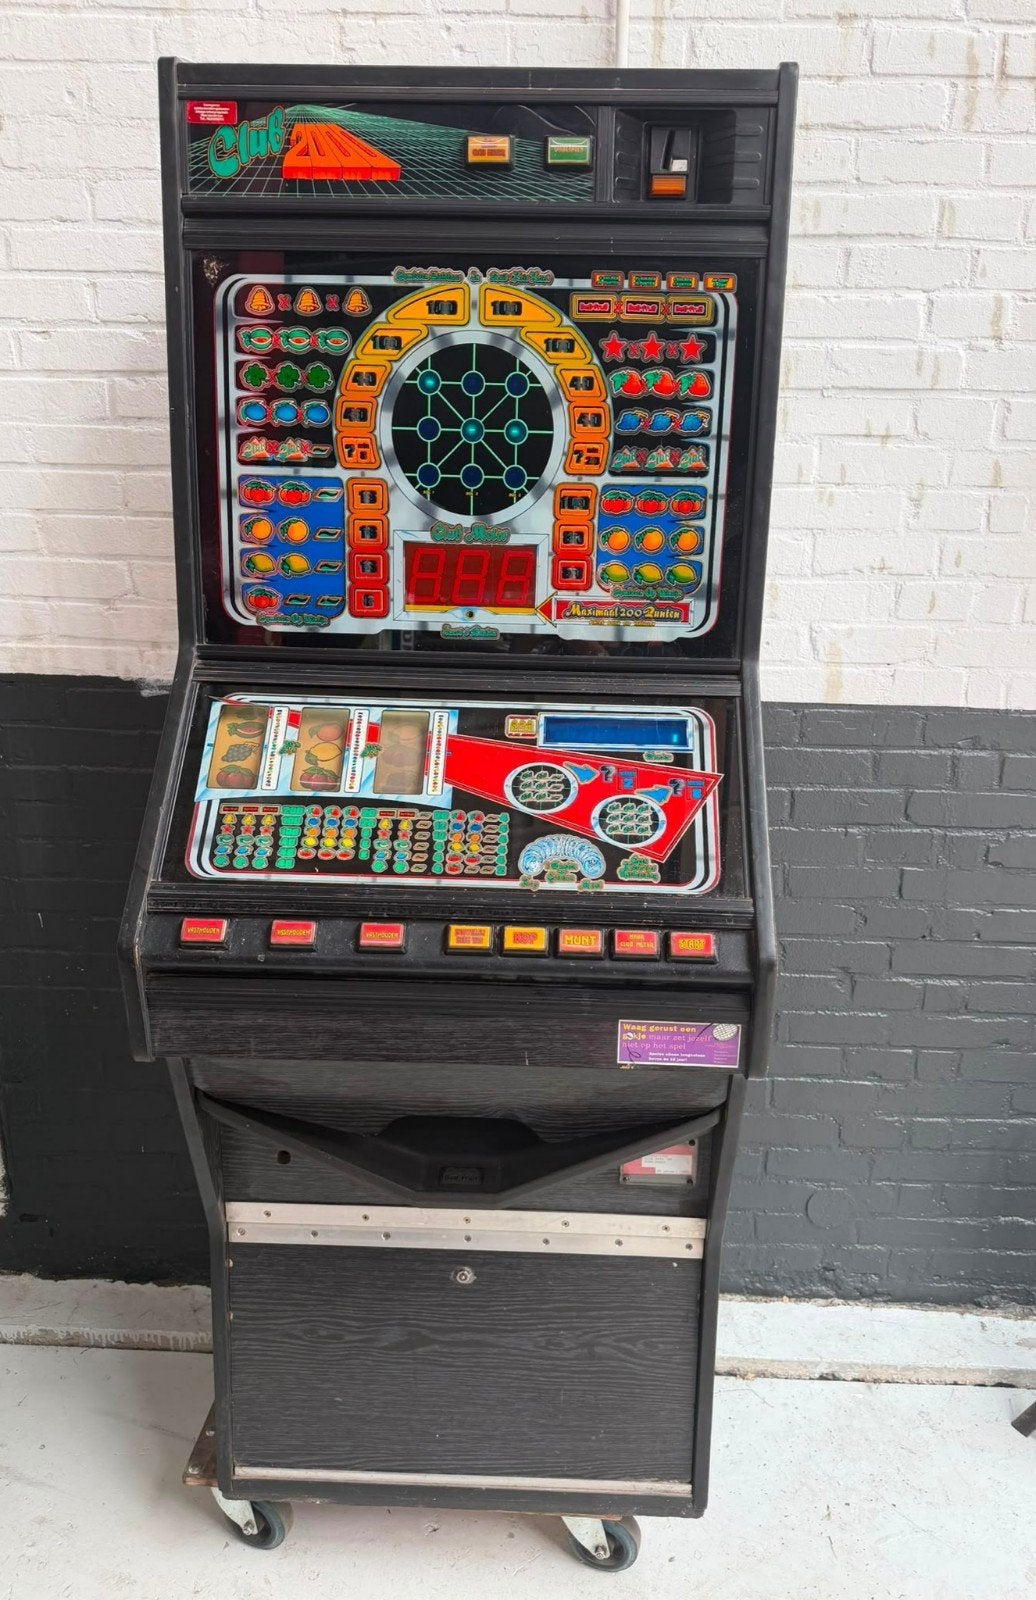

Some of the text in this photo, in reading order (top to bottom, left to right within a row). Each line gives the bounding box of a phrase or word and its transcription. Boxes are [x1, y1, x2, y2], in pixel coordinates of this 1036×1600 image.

[565, 935, 597, 946] MUNT
[649, 1024, 677, 1033] gerust
[669, 1043, 686, 1051] spel
